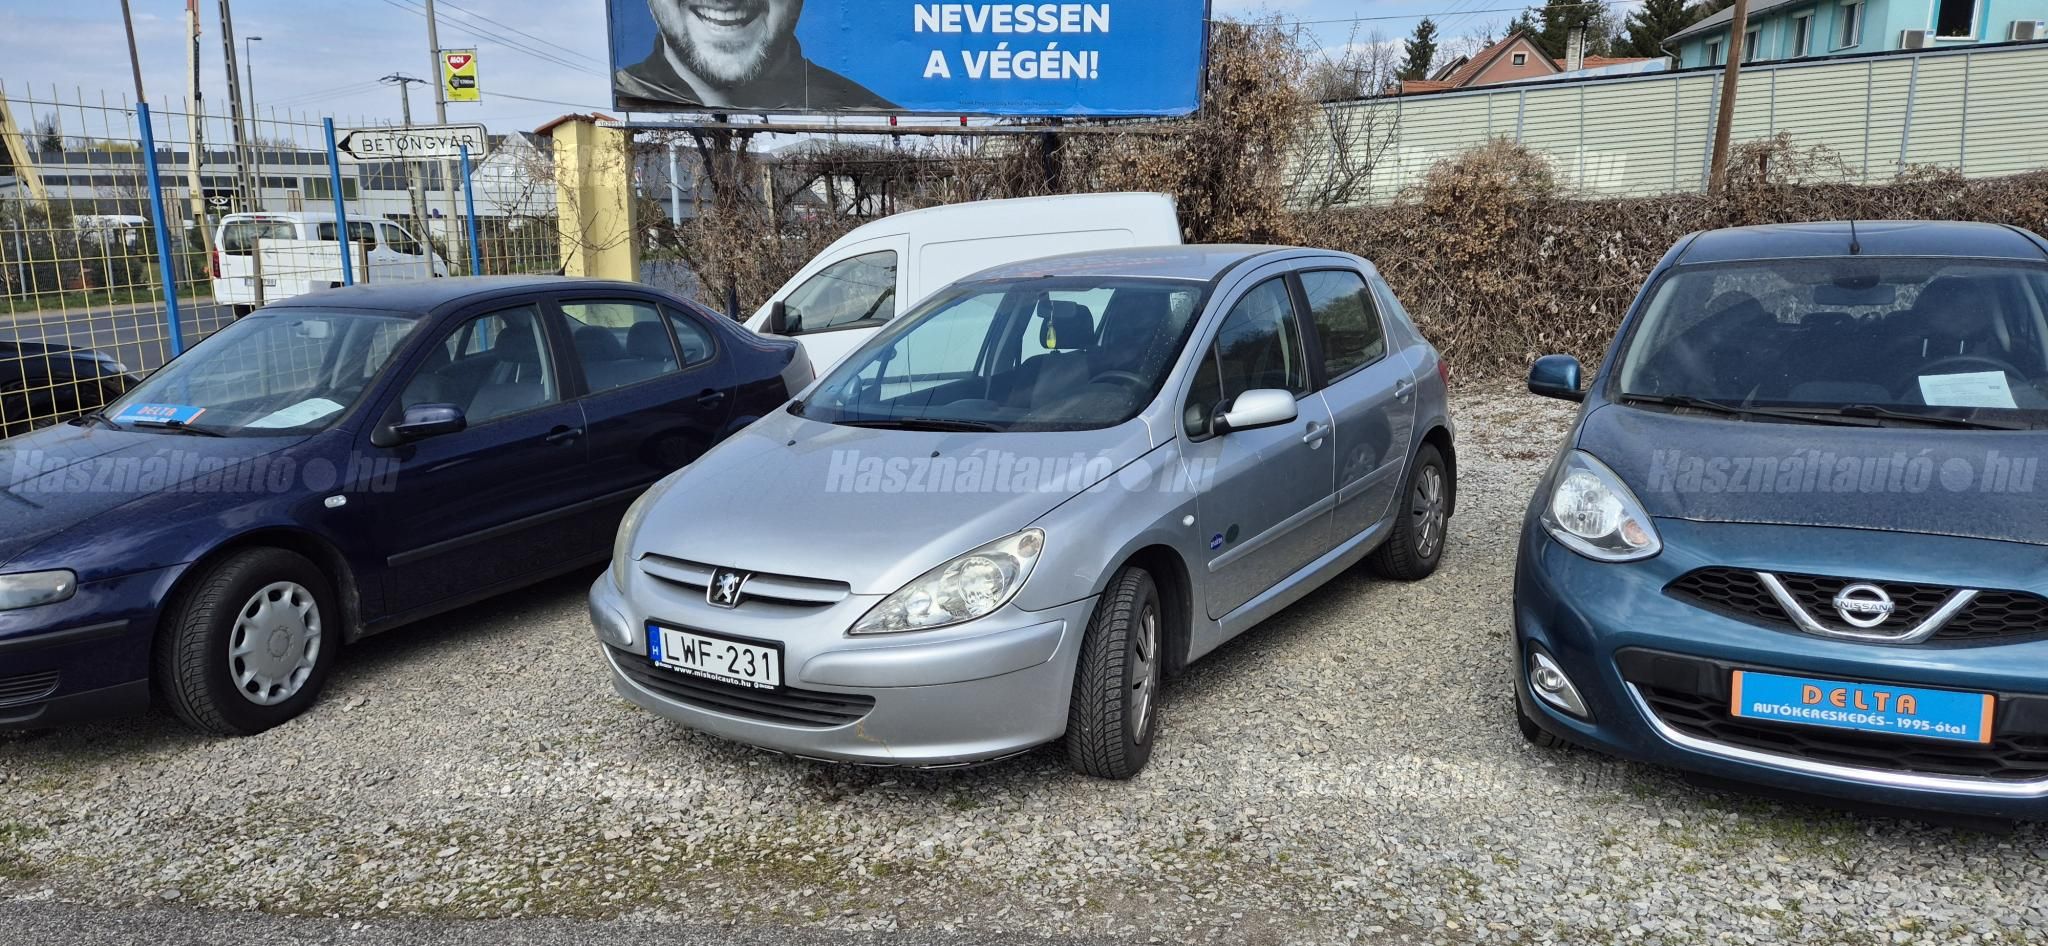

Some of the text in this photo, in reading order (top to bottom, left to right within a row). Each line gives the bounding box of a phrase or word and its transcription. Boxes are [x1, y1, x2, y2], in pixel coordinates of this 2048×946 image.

[913, 3, 1110, 33] NEVESSEN
[922, 41, 1099, 79] A VÉGÉN!
[362, 131, 474, 152] BETONGYÁR
[1840, 600, 1889, 612] NISSAN
[653, 645, 659, 655] H
[664, 632, 770, 680] LWF-231
[674, 666, 751, 688] www.miskolcauto.hu
[1802, 684, 1917, 715] DELTA
